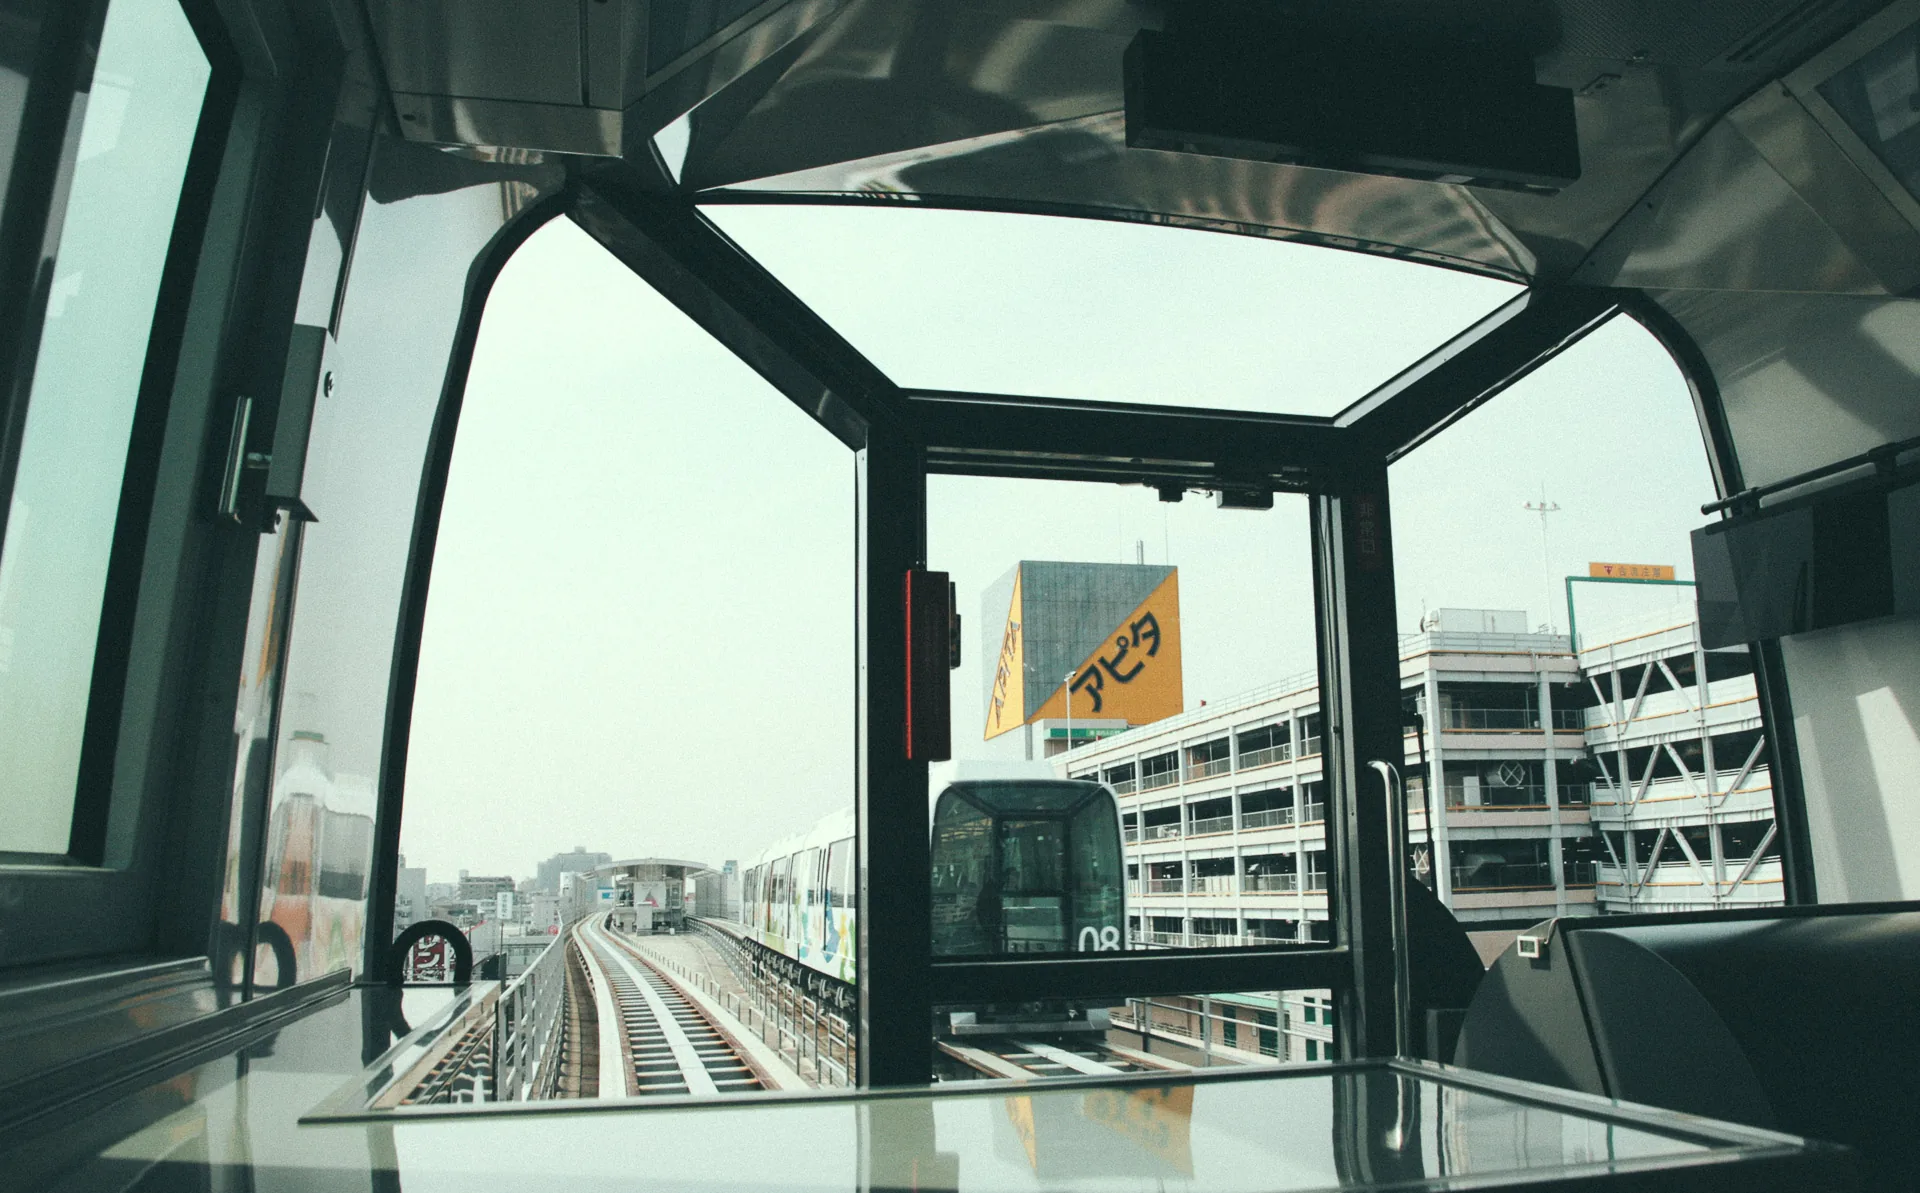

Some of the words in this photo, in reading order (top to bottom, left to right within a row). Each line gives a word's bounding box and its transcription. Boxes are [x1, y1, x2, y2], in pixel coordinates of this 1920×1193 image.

[993, 620, 1021, 729] APITA
[1069, 610, 1161, 713] アピタ
[1078, 925, 1121, 952] 08
